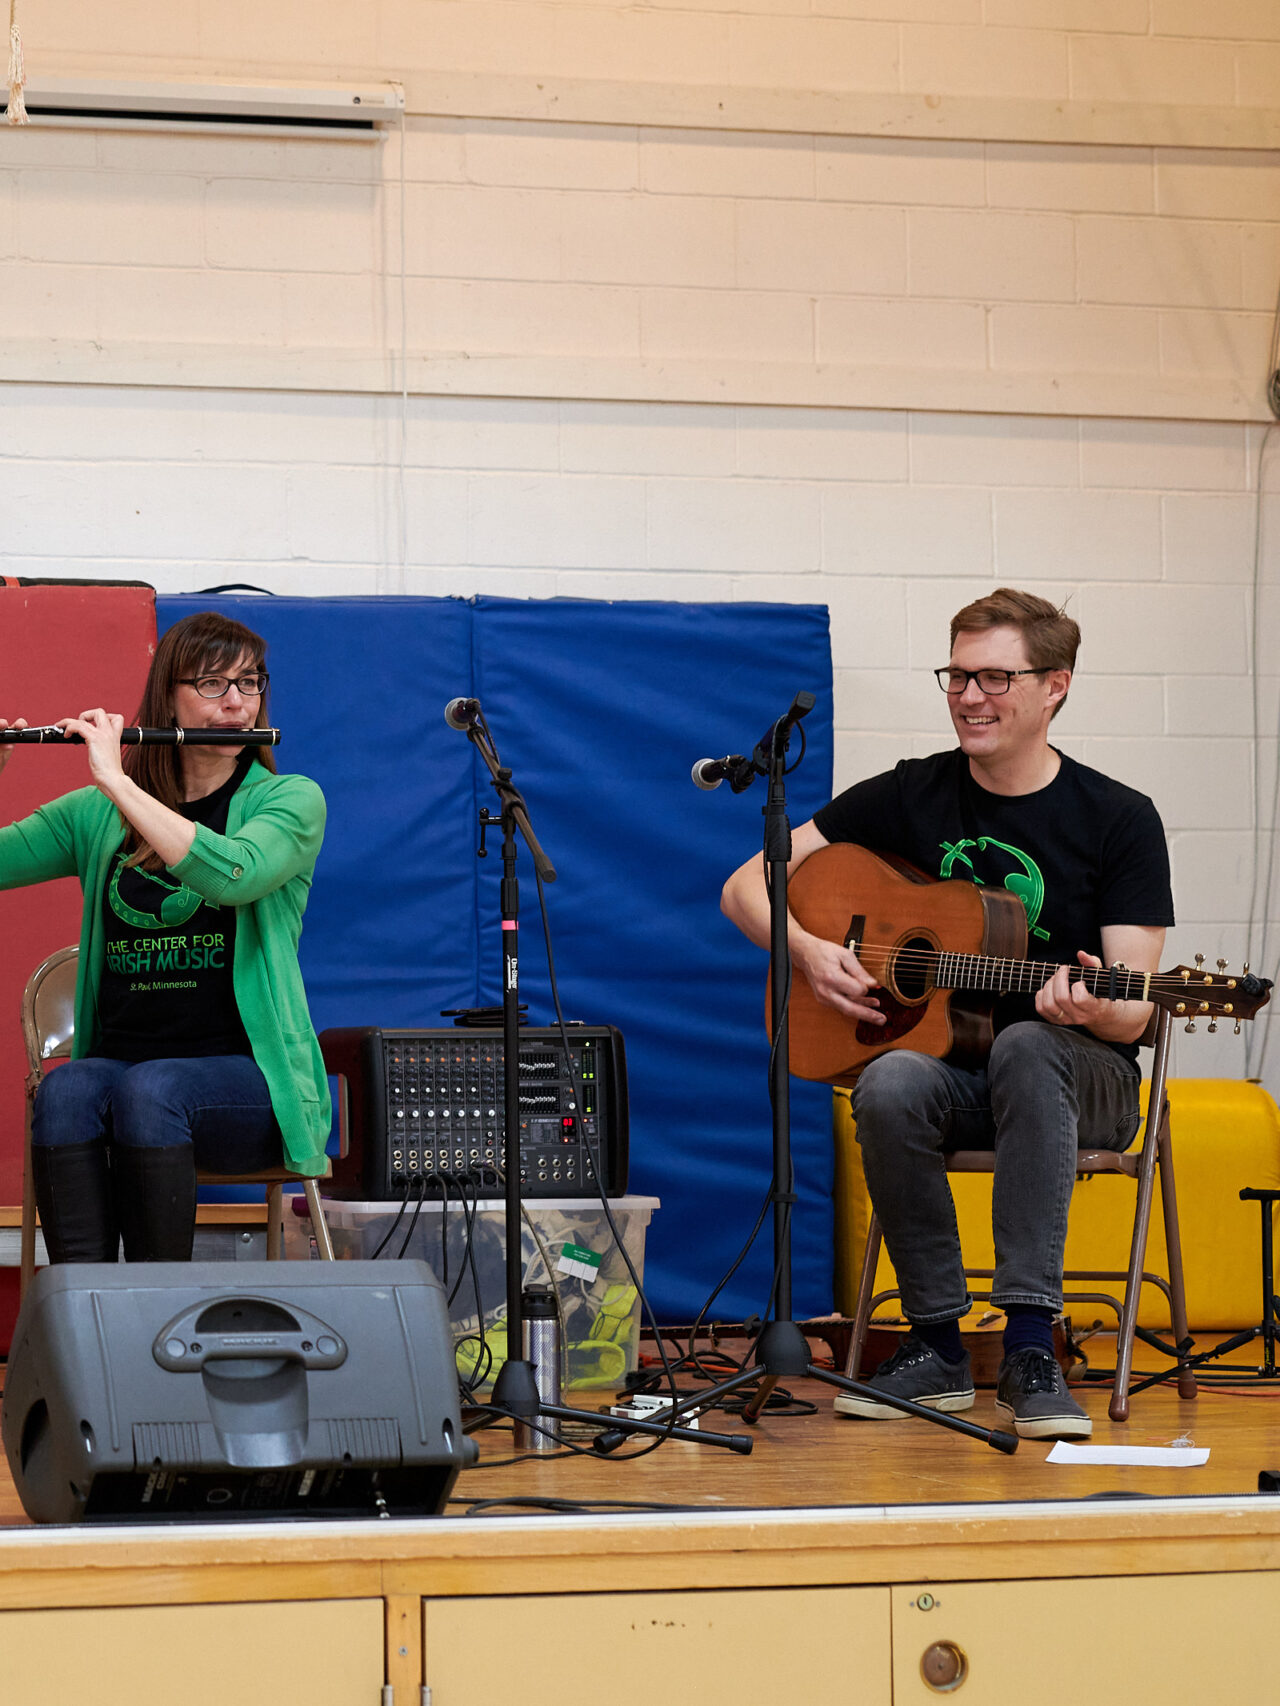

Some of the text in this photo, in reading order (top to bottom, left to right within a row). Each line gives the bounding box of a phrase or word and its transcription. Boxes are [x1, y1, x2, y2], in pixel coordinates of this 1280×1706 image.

[133, 936, 187, 951] CENTER
[193, 933, 225, 948] FOR
[106, 947, 225, 975] IRISH MUSIC
[152, 980, 197, 990] Minnesota
